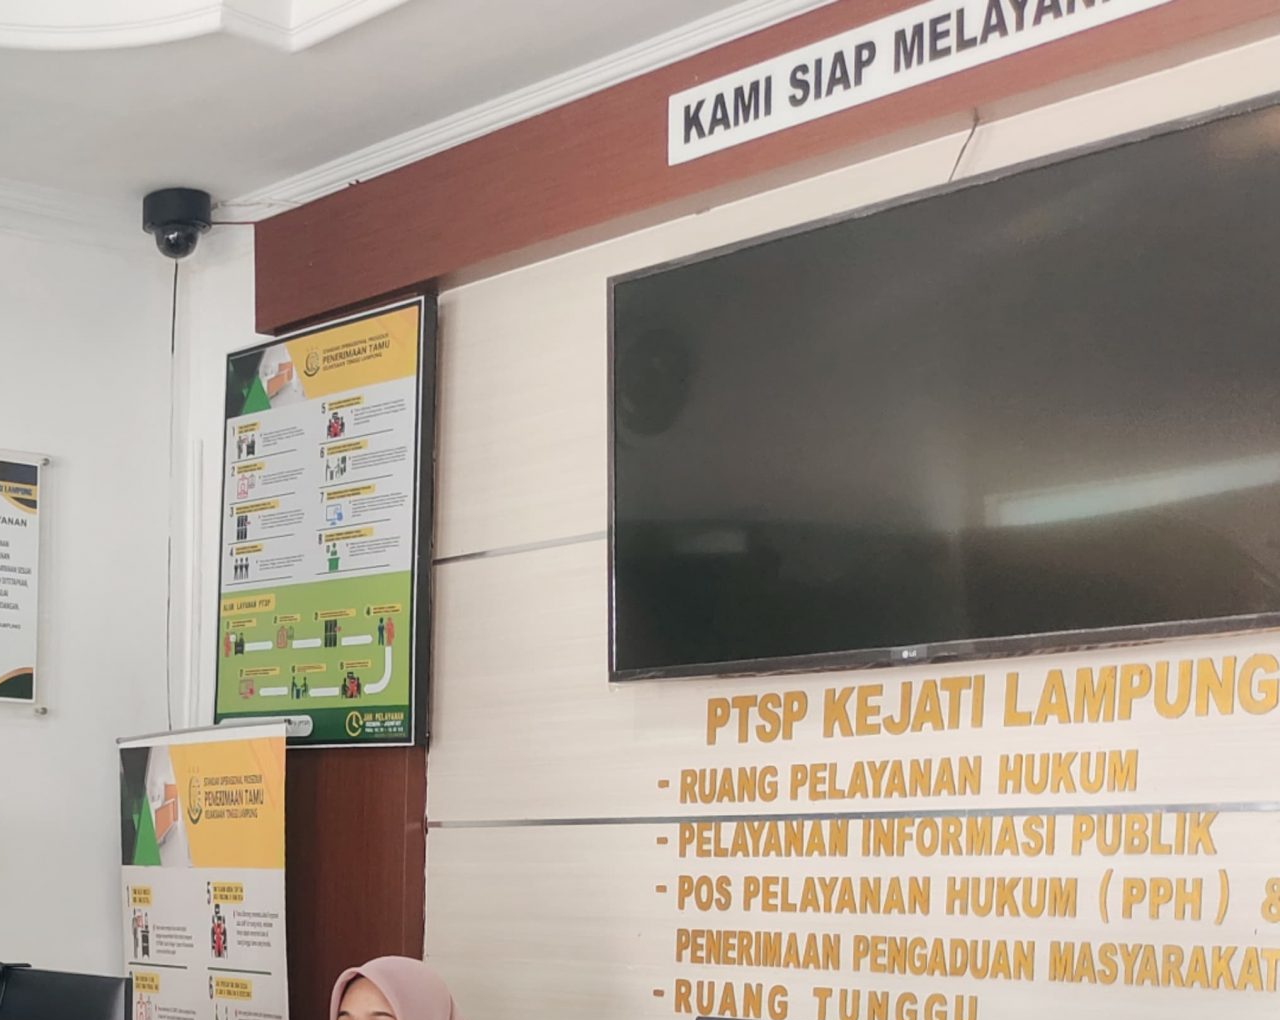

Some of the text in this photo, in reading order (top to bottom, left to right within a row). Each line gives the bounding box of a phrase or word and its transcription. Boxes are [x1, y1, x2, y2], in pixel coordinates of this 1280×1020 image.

[684, 0, 1110, 144] KAMI SIAP MELAYA
[322, 339, 390, 364] PENERIMAAN TAMU
[706, 652, 1280, 746] PTSP KEJATI LAMPUNG
[205, 788, 264, 808] PENERIMAAN TAMU
[680, 765, 778, 805] RUANG
[790, 755, 982, 801] PELAYANAN
[998, 749, 1139, 795] HUKUM
[678, 819, 848, 858] PELAYANAN
[862, 814, 1056, 858] INFORMASI
[1071, 811, 1220, 857] PUBLIK
[678, 875, 732, 912] POS
[743, 876, 930, 916] PELAYANAN
[945, 876, 1078, 919] HUKUM
[675, 928, 1280, 993] PENERIMAAN PENGADUAN MASYARAKAT
